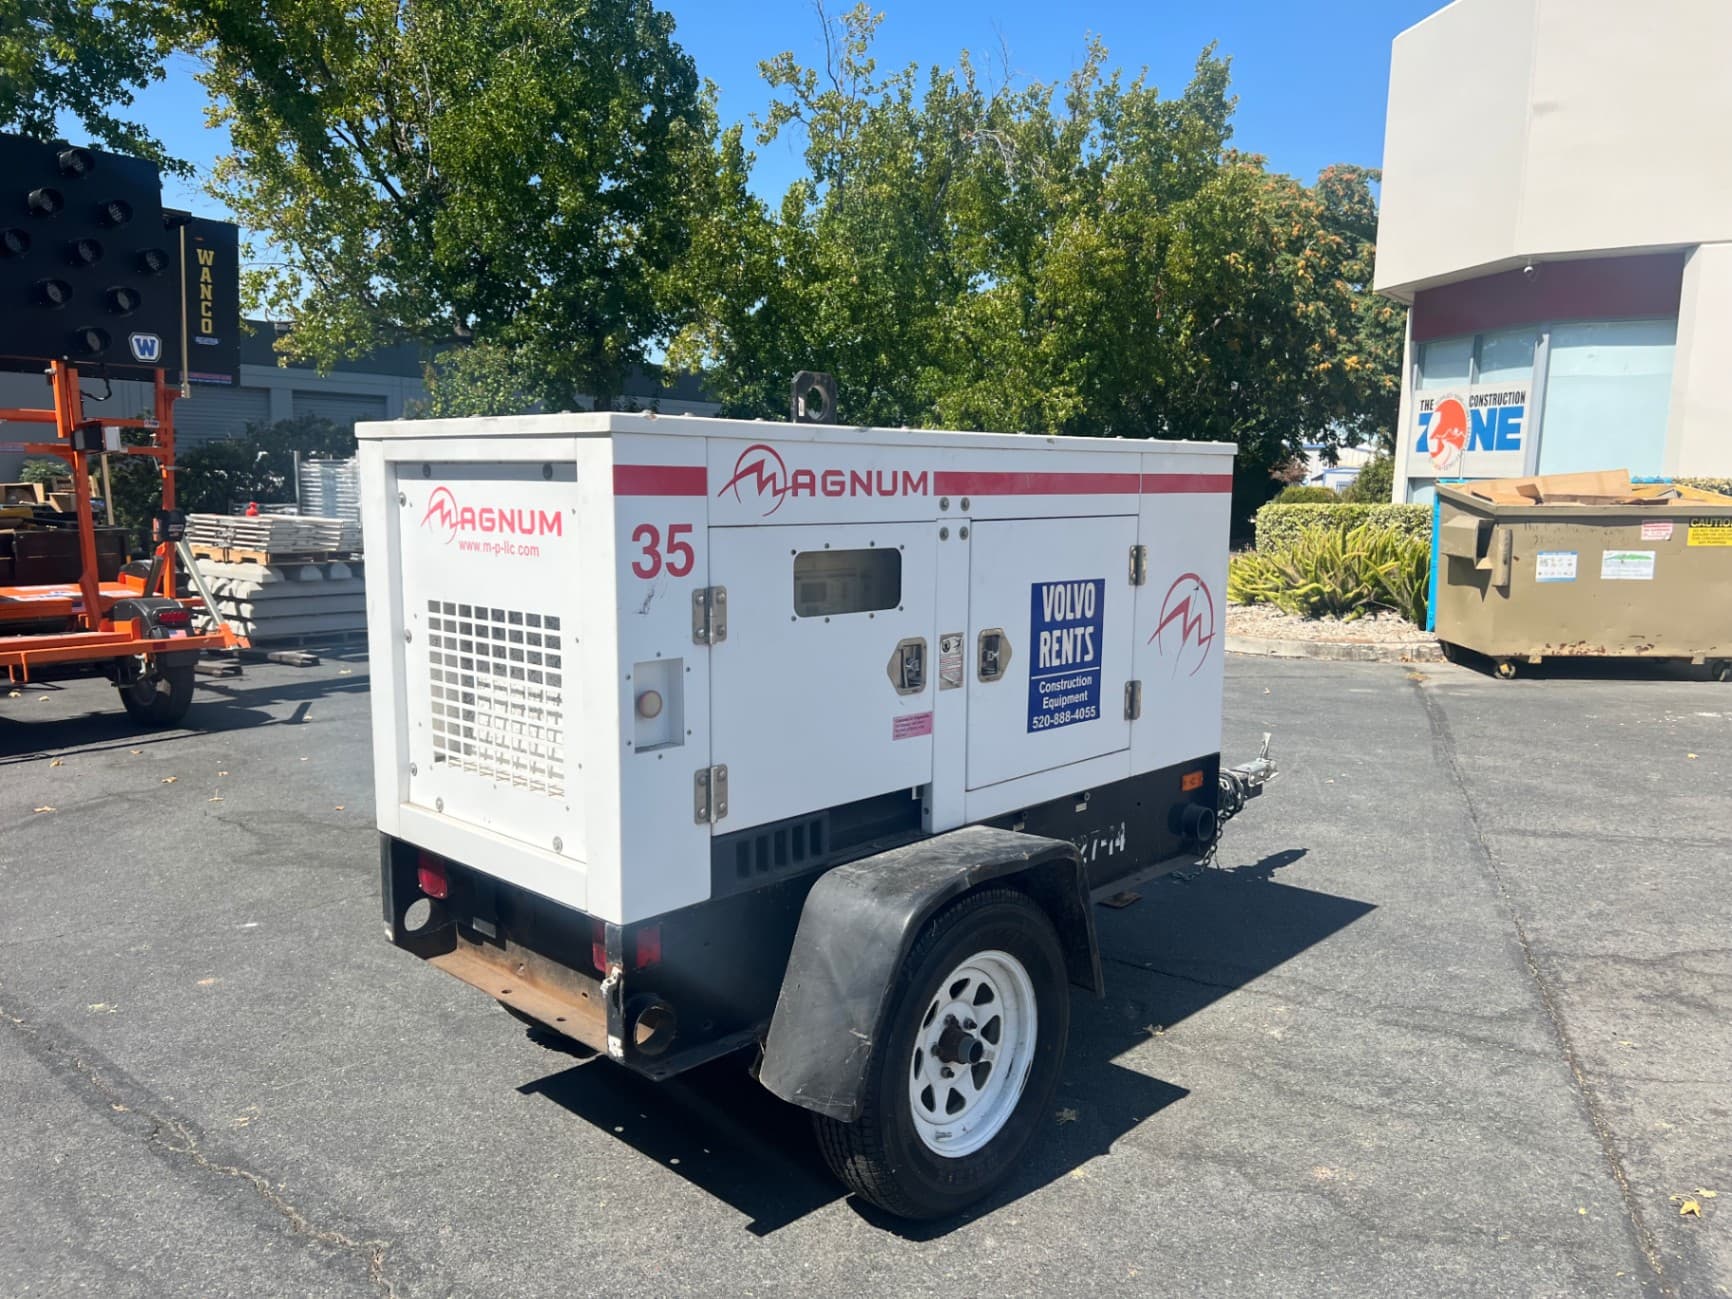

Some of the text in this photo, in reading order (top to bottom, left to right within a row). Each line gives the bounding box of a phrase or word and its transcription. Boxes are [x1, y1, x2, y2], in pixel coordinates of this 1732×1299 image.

[196, 249, 215, 334] WANCO
[133, 338, 156, 356] W
[1420, 399, 1435, 411] THE
[1468, 390, 1527, 408] CONSTRUCTION
[717, 444, 929, 517] MAGNUM
[420, 486, 563, 544] MAGNUM
[1690, 518, 1732, 527] CAUTIO
[458, 540, 540, 557] www.m-p-llc.com
[631, 523, 695, 579] 35
[1042, 582, 1096, 623] VOLVO
[1039, 626, 1094, 668] RENTS
[1039, 675, 1092, 694] Construction
[1042, 690, 1088, 710] Equipment
[1032, 705, 1096, 729] 520-888-4055
